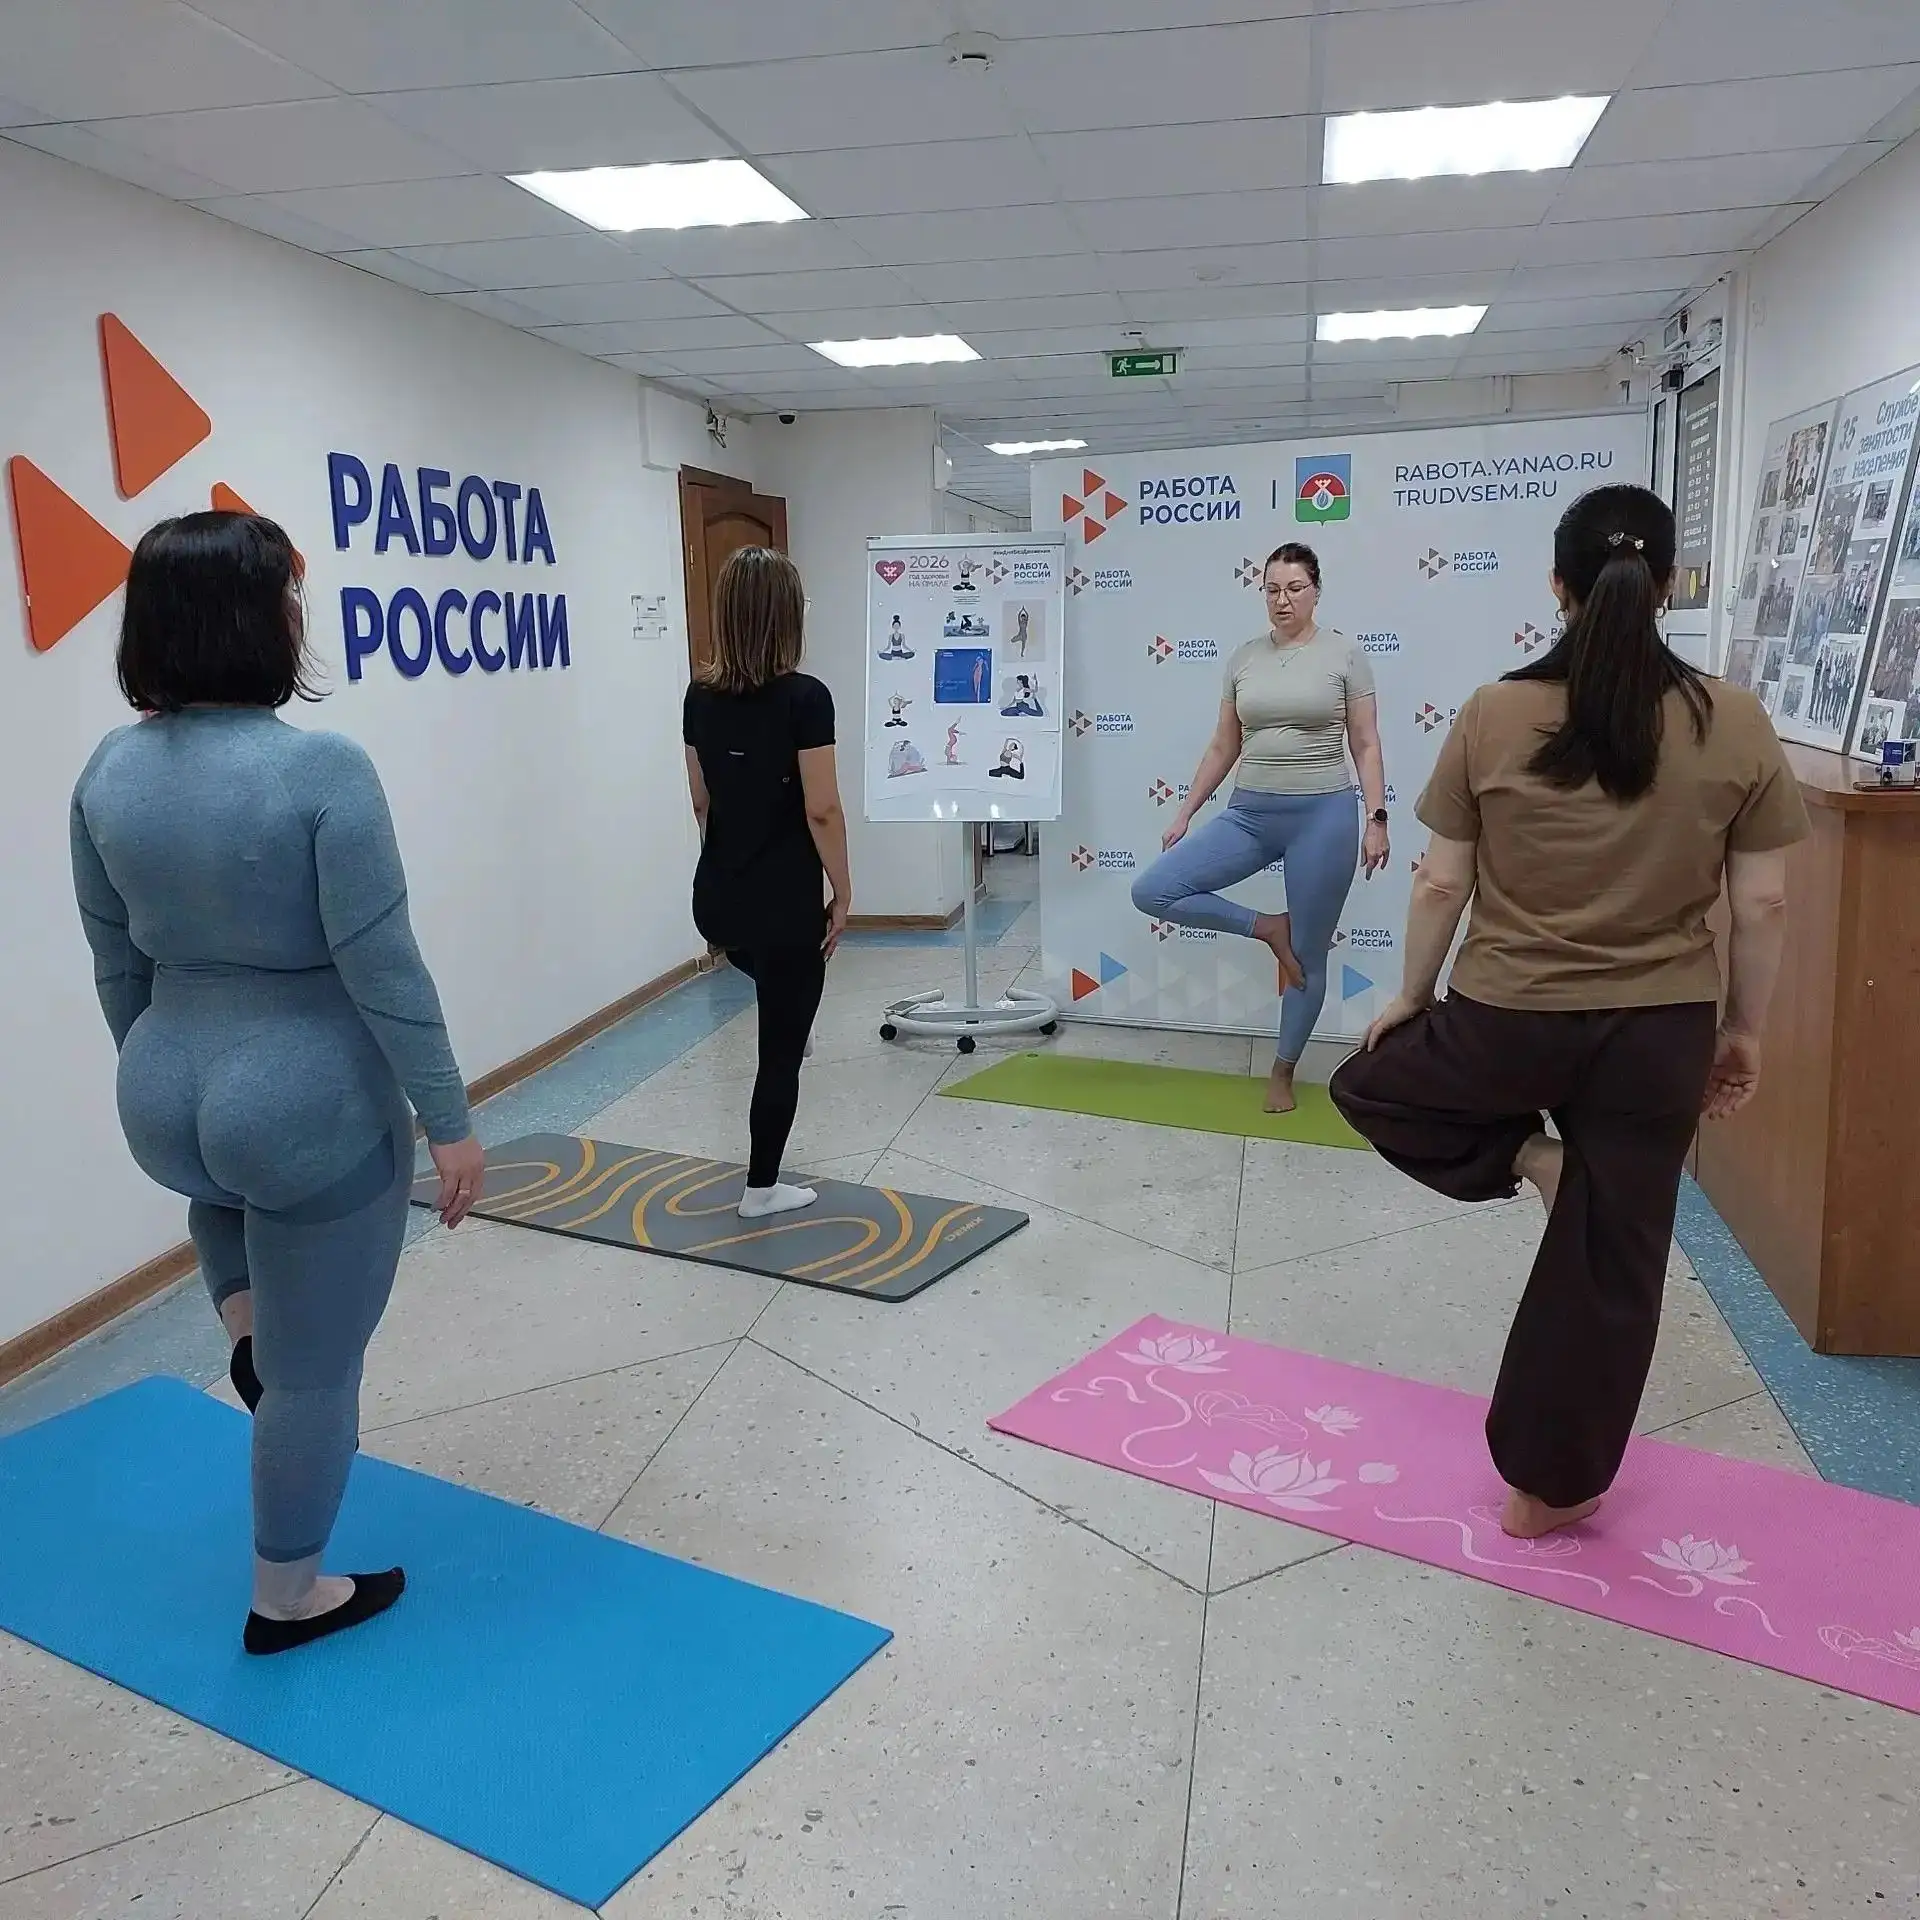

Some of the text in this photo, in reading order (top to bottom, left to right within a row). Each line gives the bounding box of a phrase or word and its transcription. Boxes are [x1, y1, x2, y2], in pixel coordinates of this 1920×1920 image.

[1839, 415, 1858, 451] 35
[1395, 451, 1613, 482] RABOTA.YANAO.RU
[1852, 448, 1908, 480] населения
[1140, 475, 1236, 500] РАБОТА
[1393, 480, 1557, 506] TRUDVSEM.RU
[328, 452, 556, 565] РАБОТА
[1140, 500, 1241, 525] РОССИИ
[1454, 551, 1497, 561] РАБОТА
[909, 555, 950, 569] 2026
[1014, 562, 1049, 570] РАБОТА
[1453, 561, 1499, 571] РОССИИ
[1014, 570, 1051, 579] РОССИИ
[1094, 570, 1131, 579] РАБОТА
[1094, 579, 1133, 588] РОССИИ
[340, 586, 571, 682] РОССИИ
[1357, 633, 1398, 641] РАБОТА
[1178, 640, 1216, 648] РАБОТА
[1363, 643, 1400, 651] ОССИИ
[1178, 649, 1218, 658] РОССИИ
[1096, 723, 1134, 731] РОССИИ
[1098, 859, 1136, 868] РОССИИ
[1179, 930, 1217, 939] РОССИИ
[1351, 929, 1391, 938] РАБОТА
[1351, 938, 1393, 947] РОССИИ
